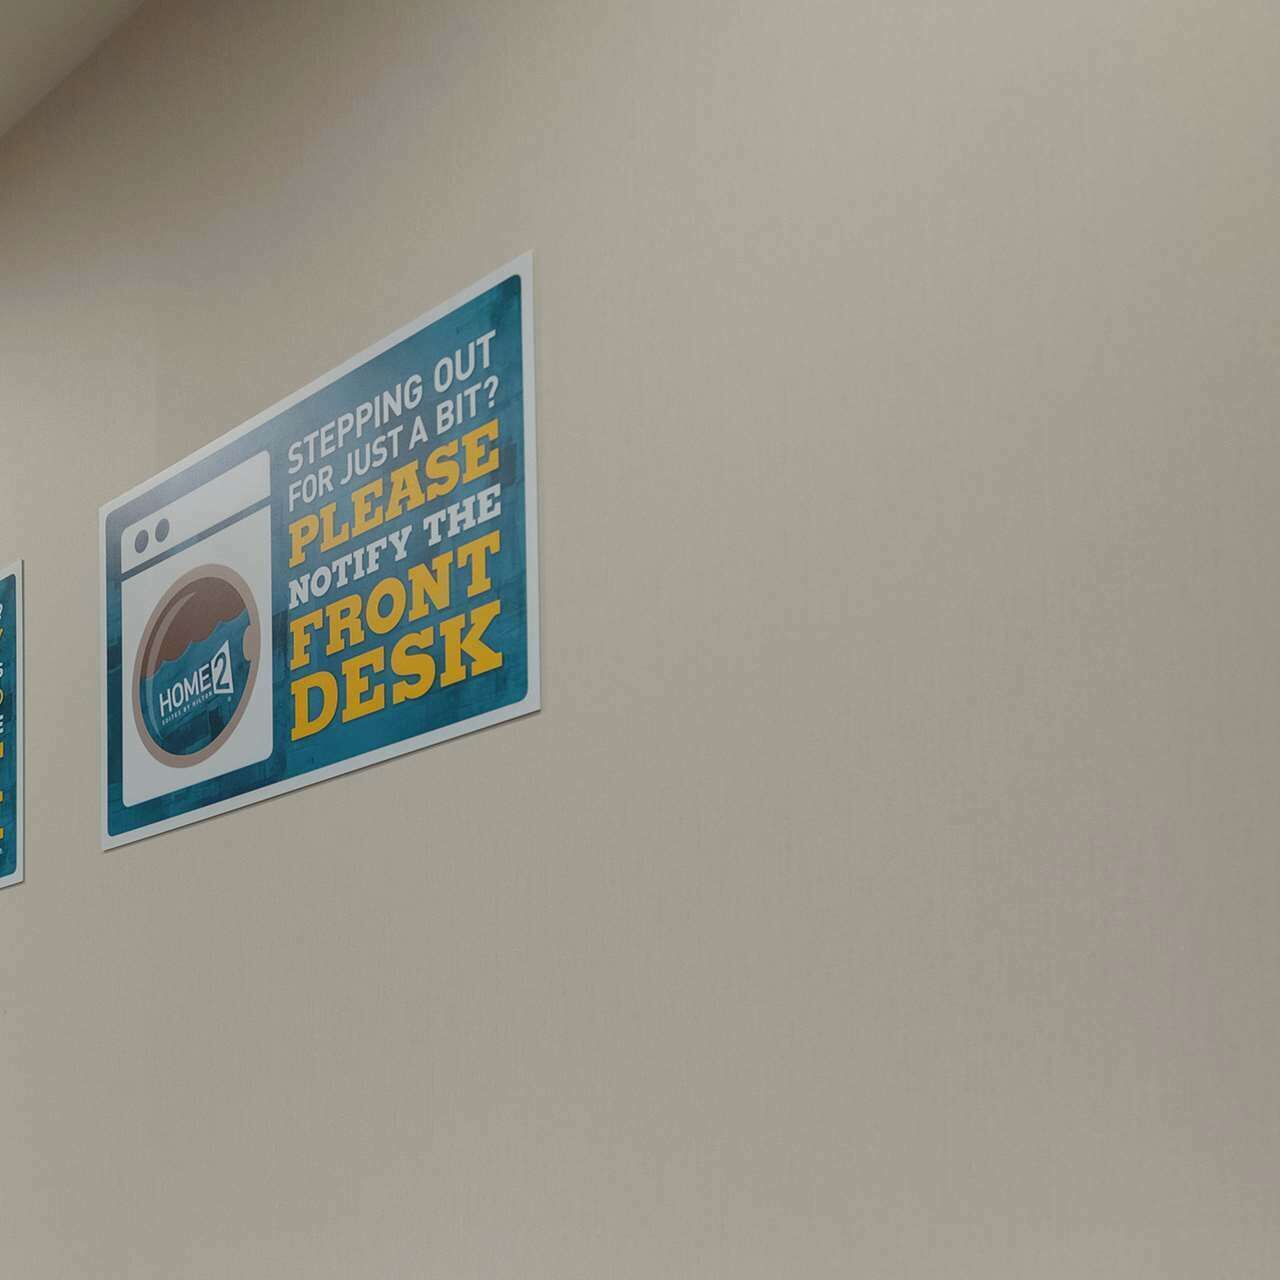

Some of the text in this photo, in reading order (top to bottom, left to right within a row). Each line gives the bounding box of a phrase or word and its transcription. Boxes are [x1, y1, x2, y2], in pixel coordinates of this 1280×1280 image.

[288, 329, 497, 474] STEPPING OUT
[289, 375, 499, 512] FOR JUST A BIT?
[288, 418, 500, 568] PLEASE
[288, 484, 502, 609] NOTIFY THE
[289, 530, 501, 671] FRONT
[290, 600, 503, 741] DESK
